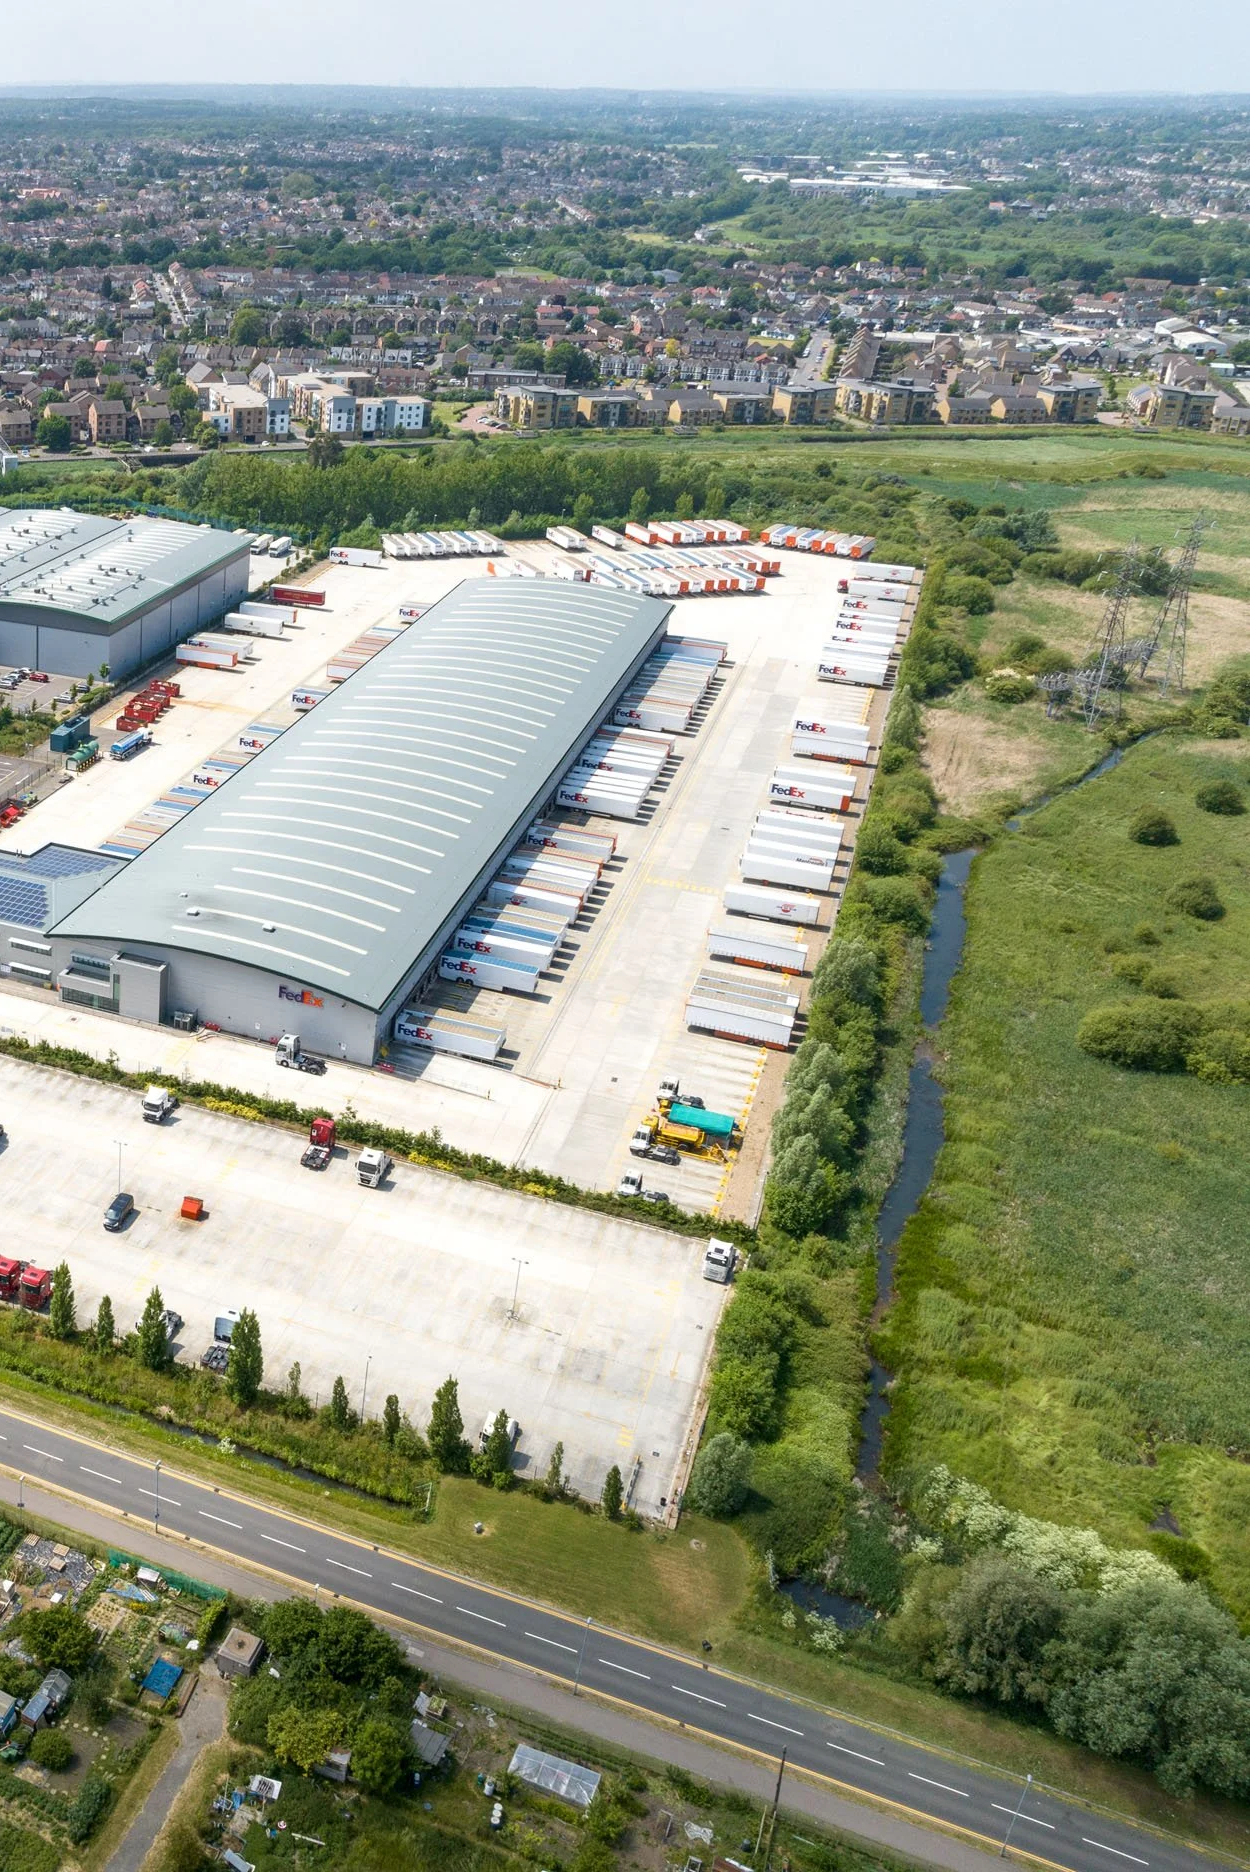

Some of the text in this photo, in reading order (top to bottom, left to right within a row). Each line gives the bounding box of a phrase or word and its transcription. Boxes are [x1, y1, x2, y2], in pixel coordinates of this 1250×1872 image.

[795, 720, 826, 733] FedEx
[193, 774, 219, 787] FedEx
[771, 783, 805, 798] FedEx
[457, 937, 492, 953] FedEx
[441, 957, 477, 974] FedEx
[278, 985, 324, 1008] FedEx
[397, 1023, 433, 1041] FedEx
